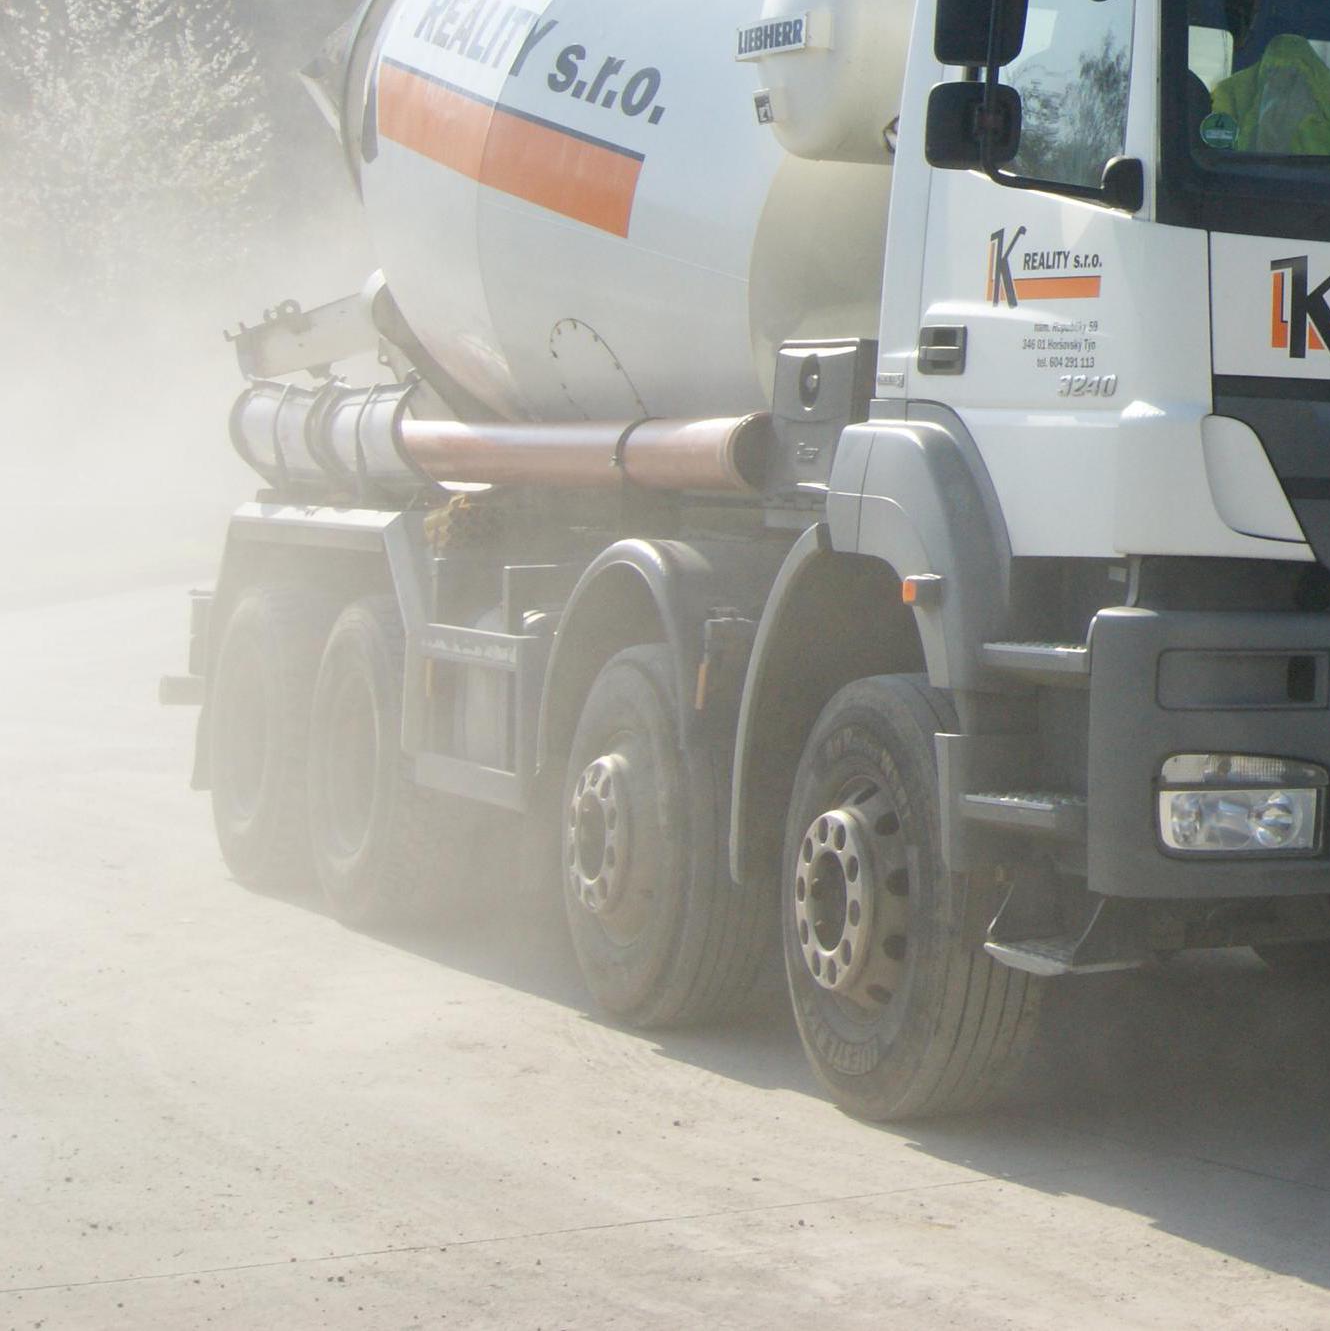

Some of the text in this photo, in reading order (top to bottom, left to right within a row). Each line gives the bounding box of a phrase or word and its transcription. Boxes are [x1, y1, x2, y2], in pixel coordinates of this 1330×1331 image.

[738, 18, 803, 55] LIEBHERR
[547, 44, 666, 125] s.r.o.
[1023, 251, 1070, 271] REALITY
[1073, 254, 1102, 269] s.r.o.
[1049, 356, 1063, 368] 604
[1064, 356, 1078, 368] 291
[1080, 356, 1095, 368] 113
